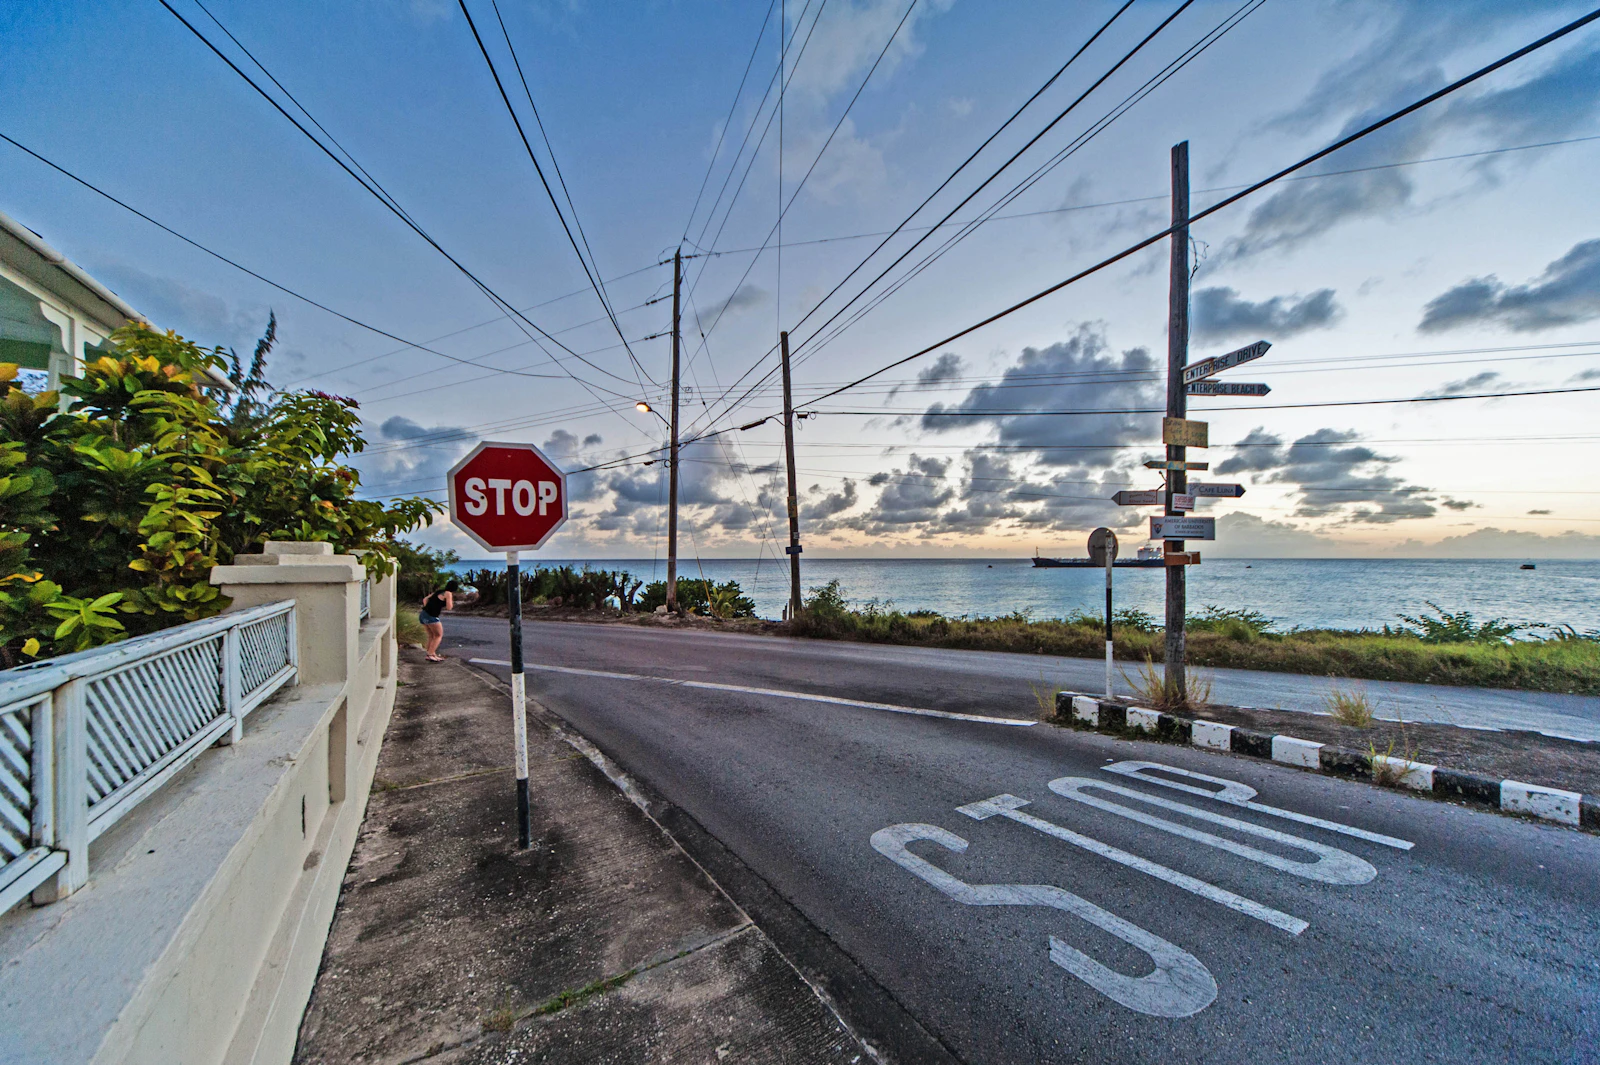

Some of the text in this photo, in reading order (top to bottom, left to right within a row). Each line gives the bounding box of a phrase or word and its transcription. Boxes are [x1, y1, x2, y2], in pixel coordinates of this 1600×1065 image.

[1186, 342, 1263, 380] ENTERPRISE DRIVE
[1187, 383, 1230, 393] ENTERPRISE
[1231, 384, 1255, 393] BEACH
[464, 477, 558, 517] STOP
[1216, 486, 1234, 494] LUNA
[869, 760, 1416, 1018] STOP
